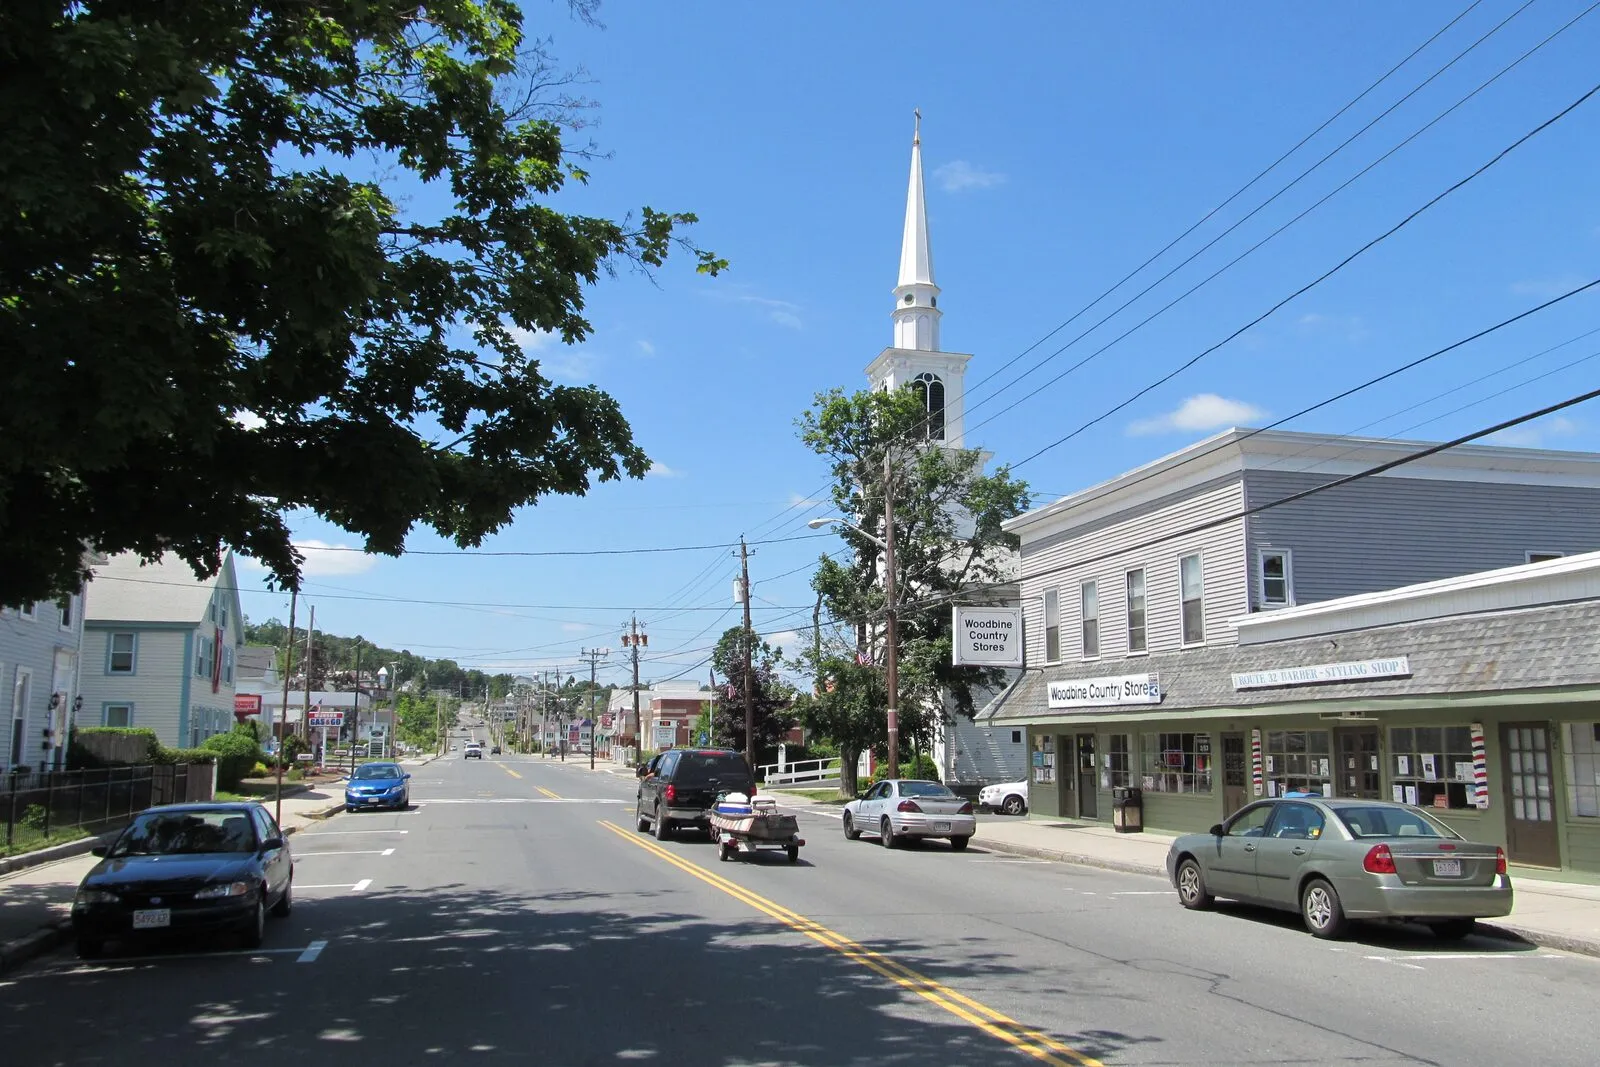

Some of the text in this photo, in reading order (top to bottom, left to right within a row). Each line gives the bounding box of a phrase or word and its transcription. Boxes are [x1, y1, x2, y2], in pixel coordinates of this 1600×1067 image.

[965, 619, 1012, 628] Woodbine
[969, 631, 1008, 641] Country
[973, 642, 1004, 651] Stores
[1238, 674, 1265, 686] ROUTE
[1268, 672, 1278, 682] 32
[1281, 668, 1318, 681] BARBER
[1325, 664, 1367, 678] STYLING
[1372, 661, 1398, 674] SHOP
[1050, 681, 1148, 700] Woodbine Country Store
